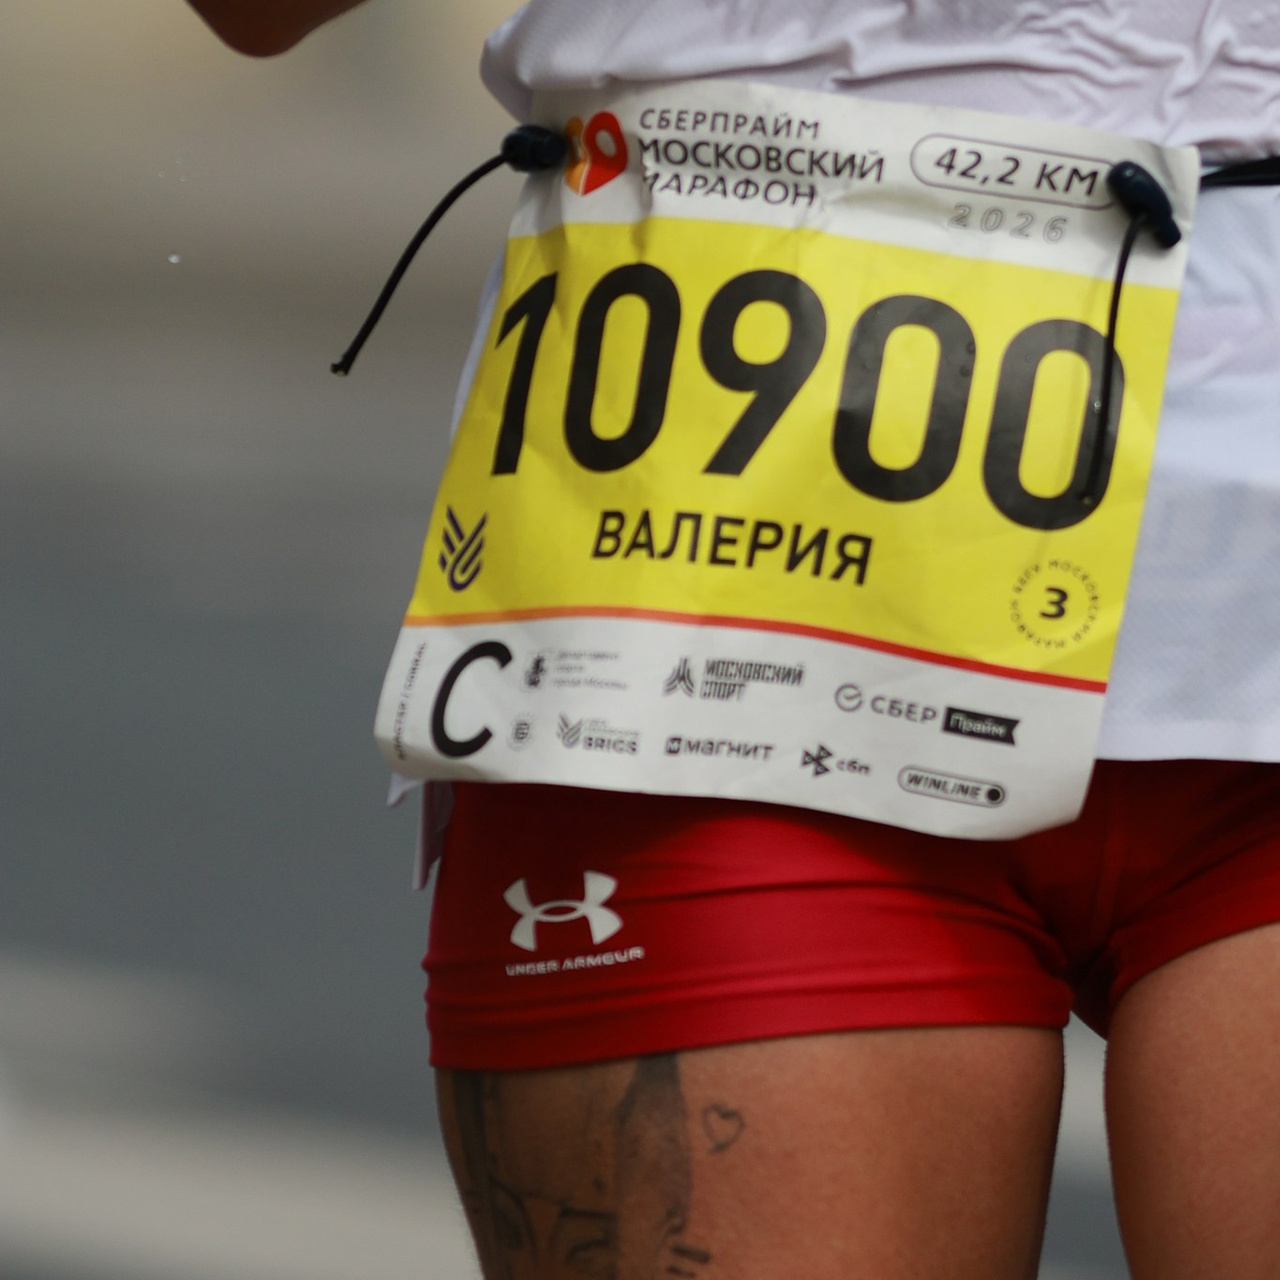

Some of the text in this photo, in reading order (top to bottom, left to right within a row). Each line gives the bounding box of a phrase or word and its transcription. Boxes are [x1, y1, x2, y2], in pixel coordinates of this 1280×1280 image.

[639, 108, 820, 140] СБЕРПРАЙМ
[638, 138, 885, 184] МОСКОВСКИЙ
[934, 148, 1099, 196] 42,2 КМ
[948, 203, 1069, 243] 2026
[490, 262, 1126, 532] 10900
[591, 509, 874, 587] ВАЛЕРИЯ
[1038, 585, 1069, 620] 3
[869, 696, 937, 723] СБЕР
[906, 772, 982, 800] WINLINE
[505, 946, 645, 976] UNDER ARMOUR
